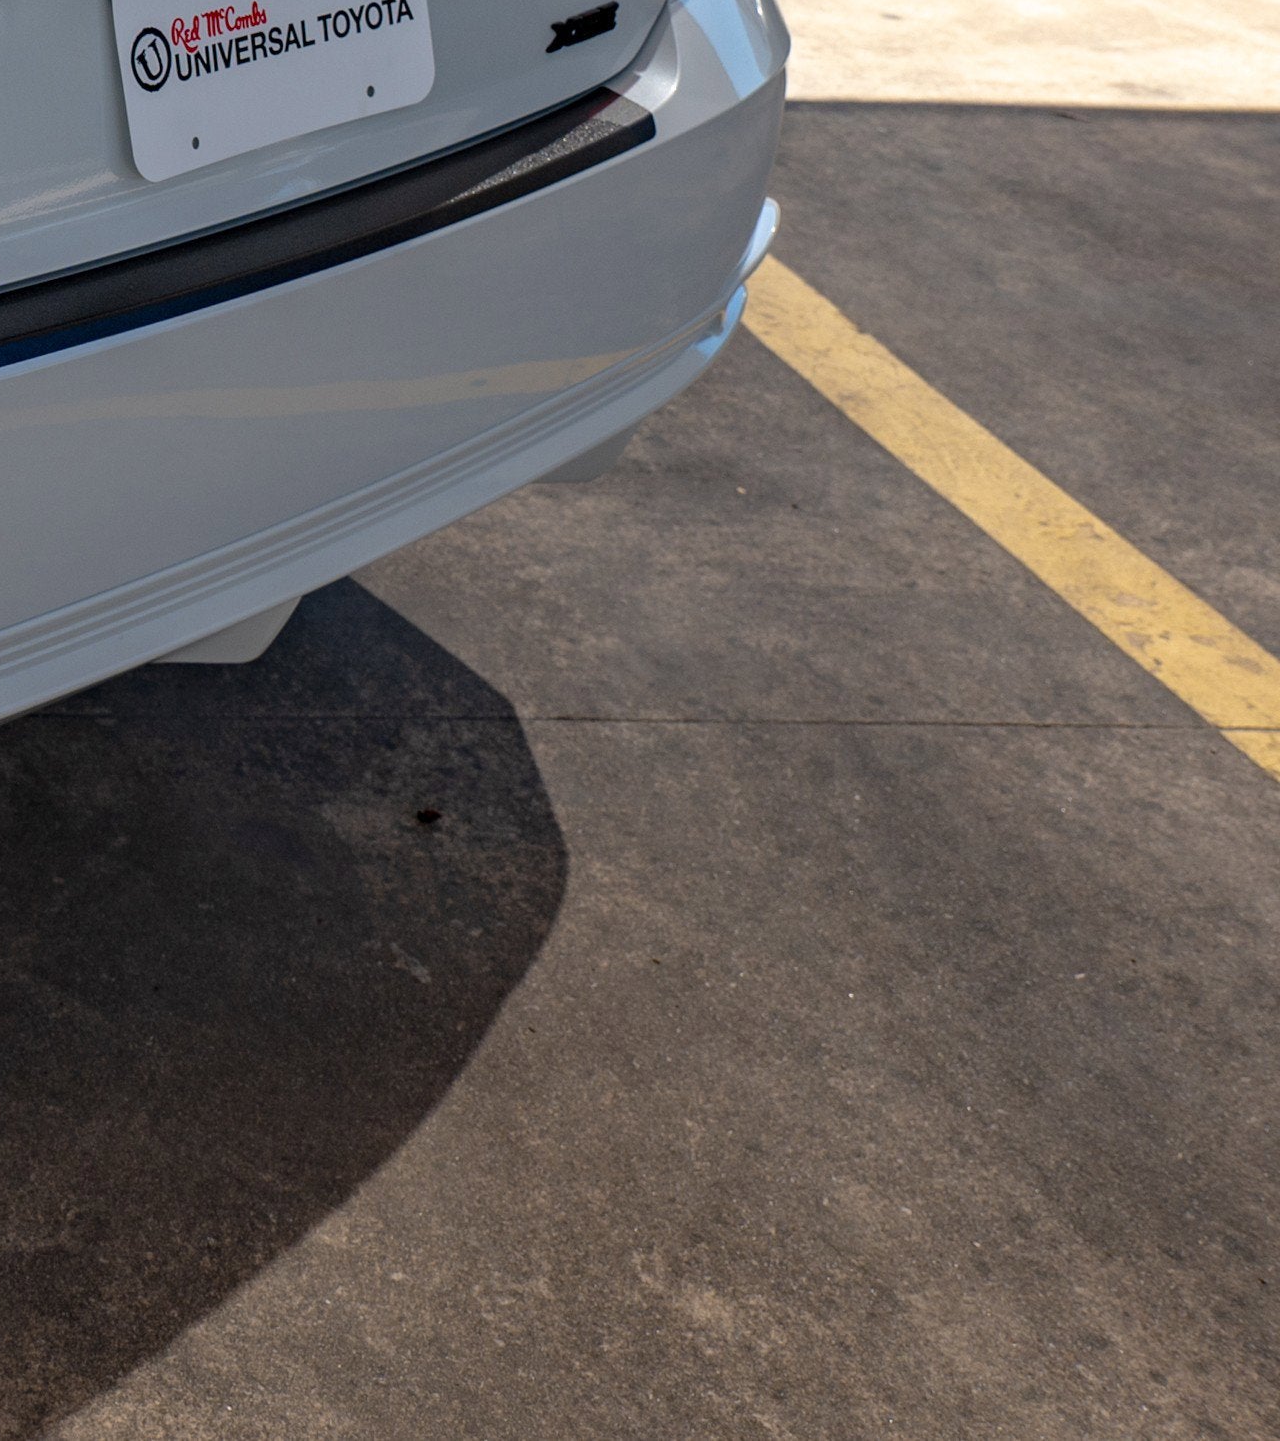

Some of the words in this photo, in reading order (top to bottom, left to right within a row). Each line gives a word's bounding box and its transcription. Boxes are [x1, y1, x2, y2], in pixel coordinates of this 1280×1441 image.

[171, 15, 201, 53] Red
[201, 1, 267, 37] McCombs
[175, 20, 316, 81] UNIVERSAL
